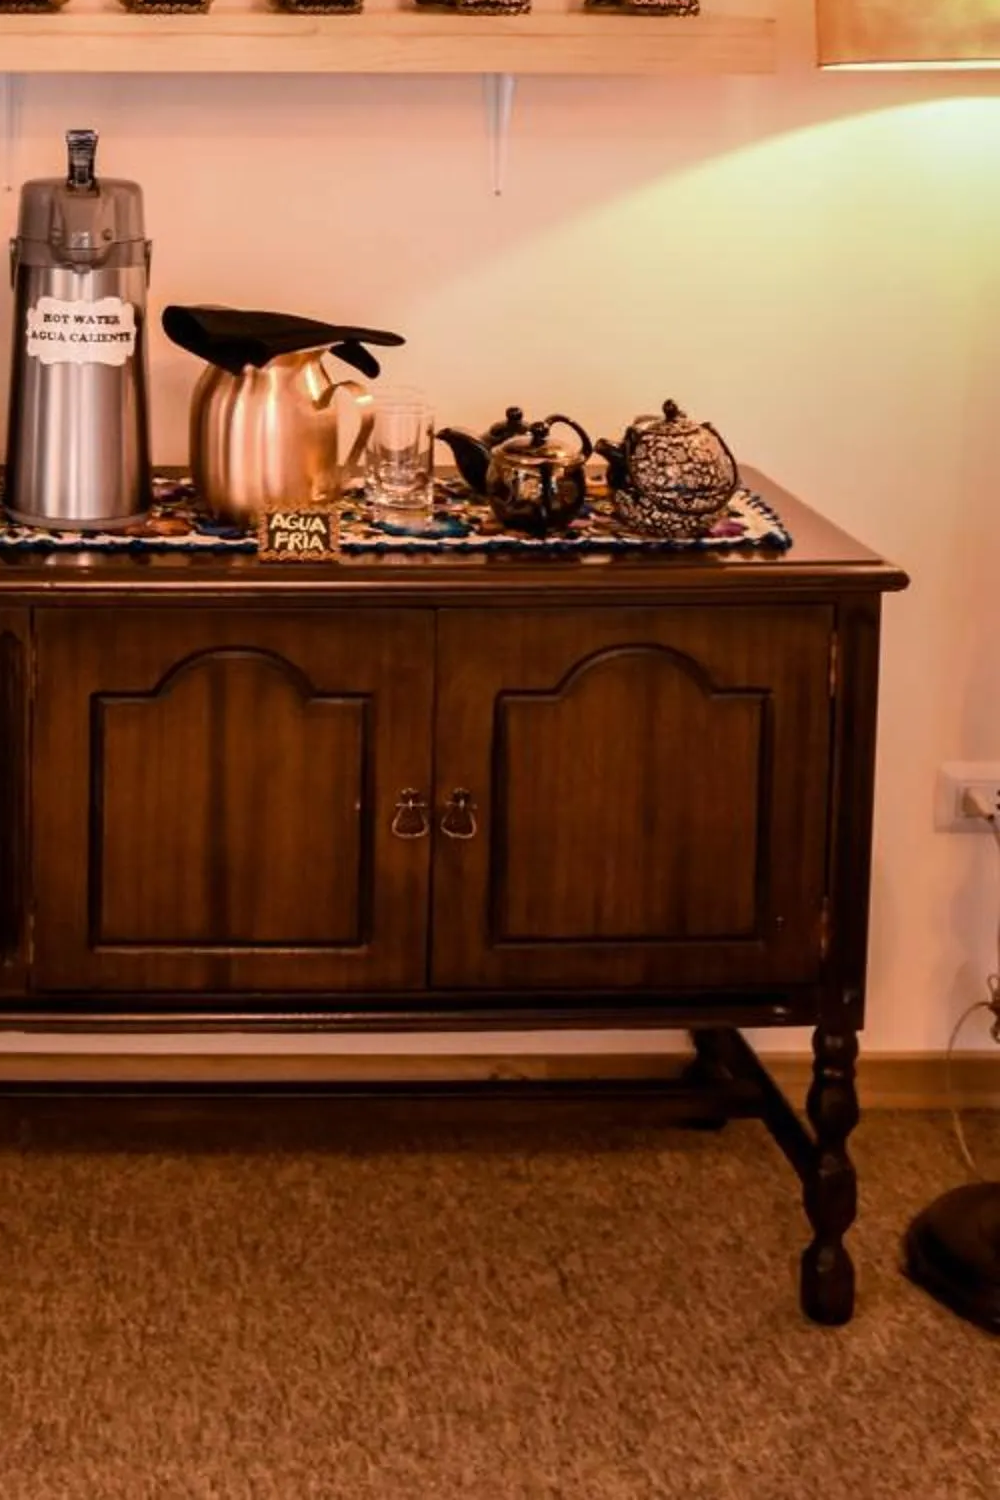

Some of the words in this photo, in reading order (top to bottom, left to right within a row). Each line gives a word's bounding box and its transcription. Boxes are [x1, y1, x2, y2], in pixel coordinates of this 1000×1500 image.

[43, 313, 70, 325] HOT
[73, 314, 120, 325] WATER
[31, 330, 66, 342] AGUA
[69, 331, 131, 343] CALIENTE
[269, 512, 328, 535] AGUA
